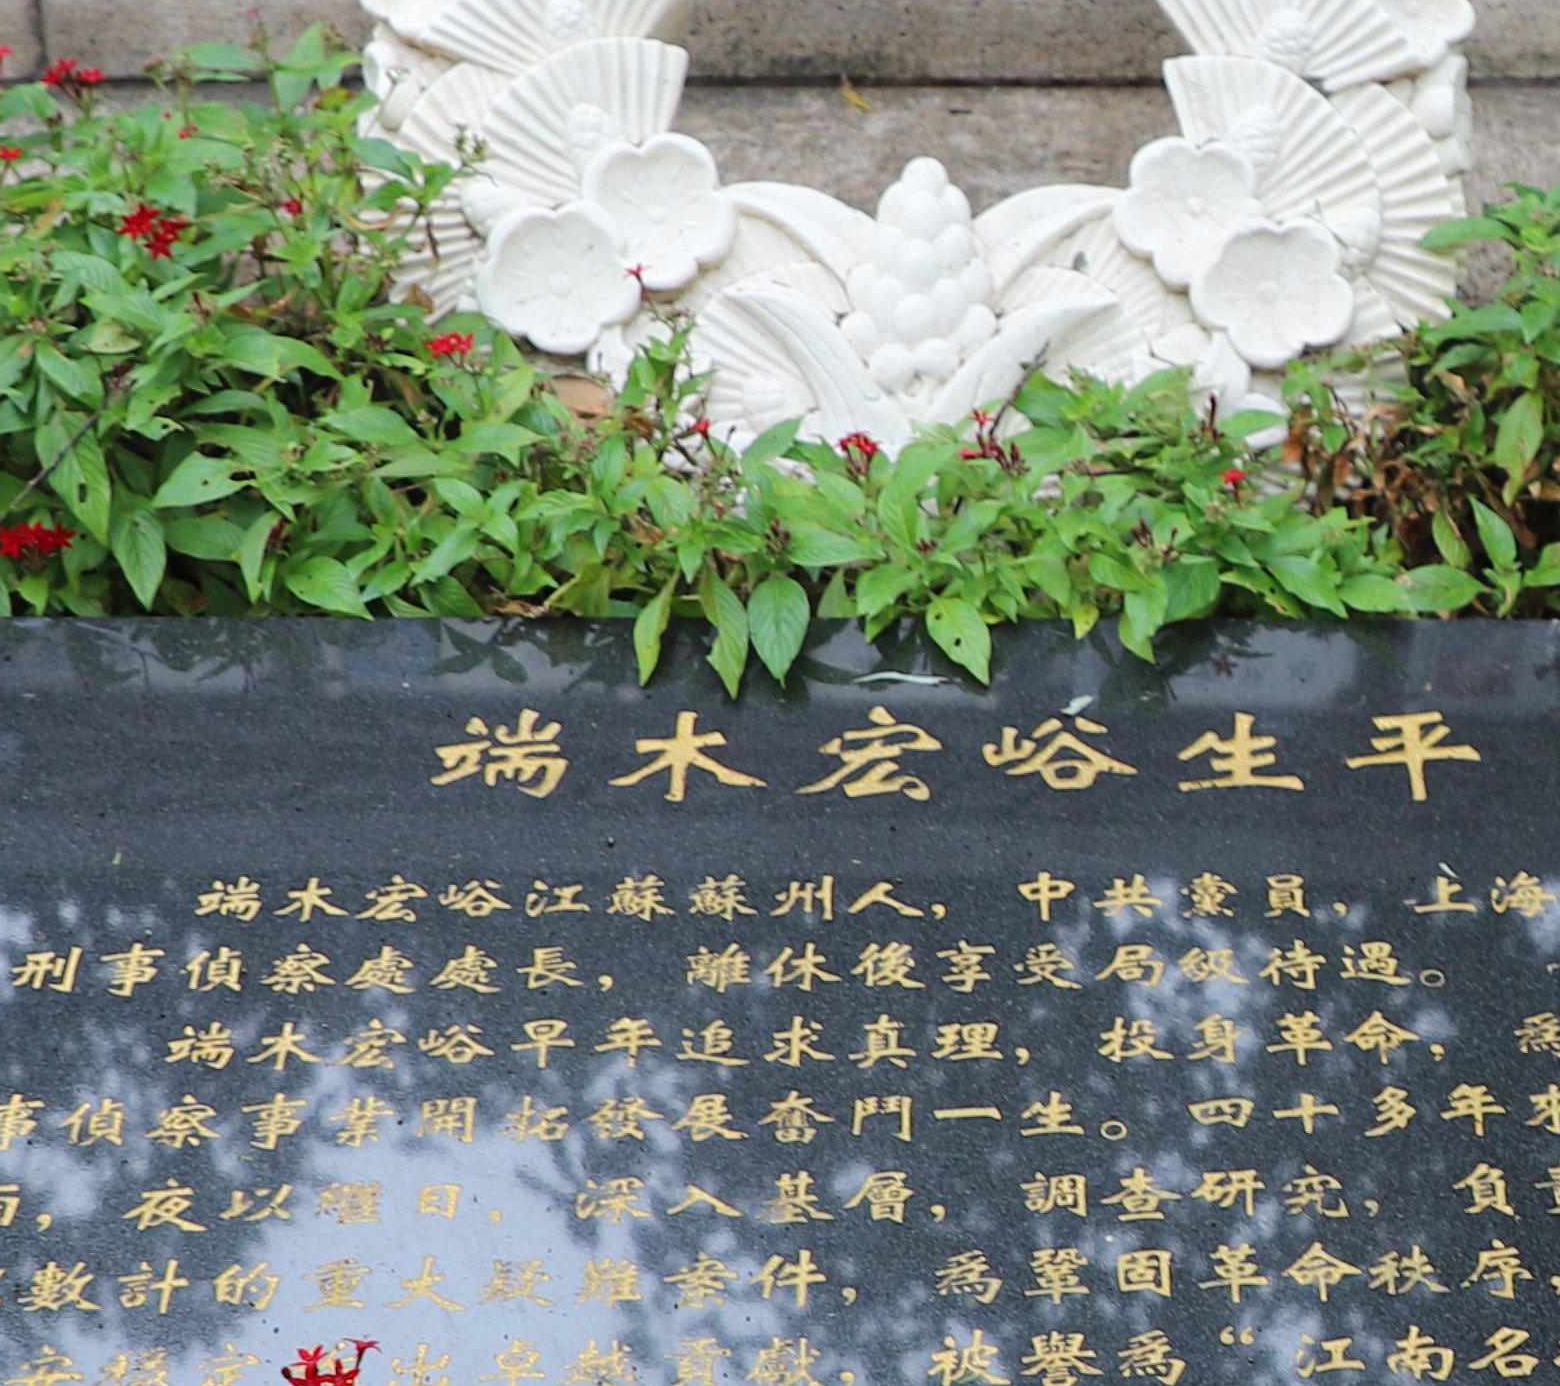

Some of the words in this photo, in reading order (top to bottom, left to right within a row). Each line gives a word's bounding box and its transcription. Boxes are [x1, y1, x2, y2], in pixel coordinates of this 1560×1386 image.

[430, 709, 1482, 801] 端木宏峪生平
